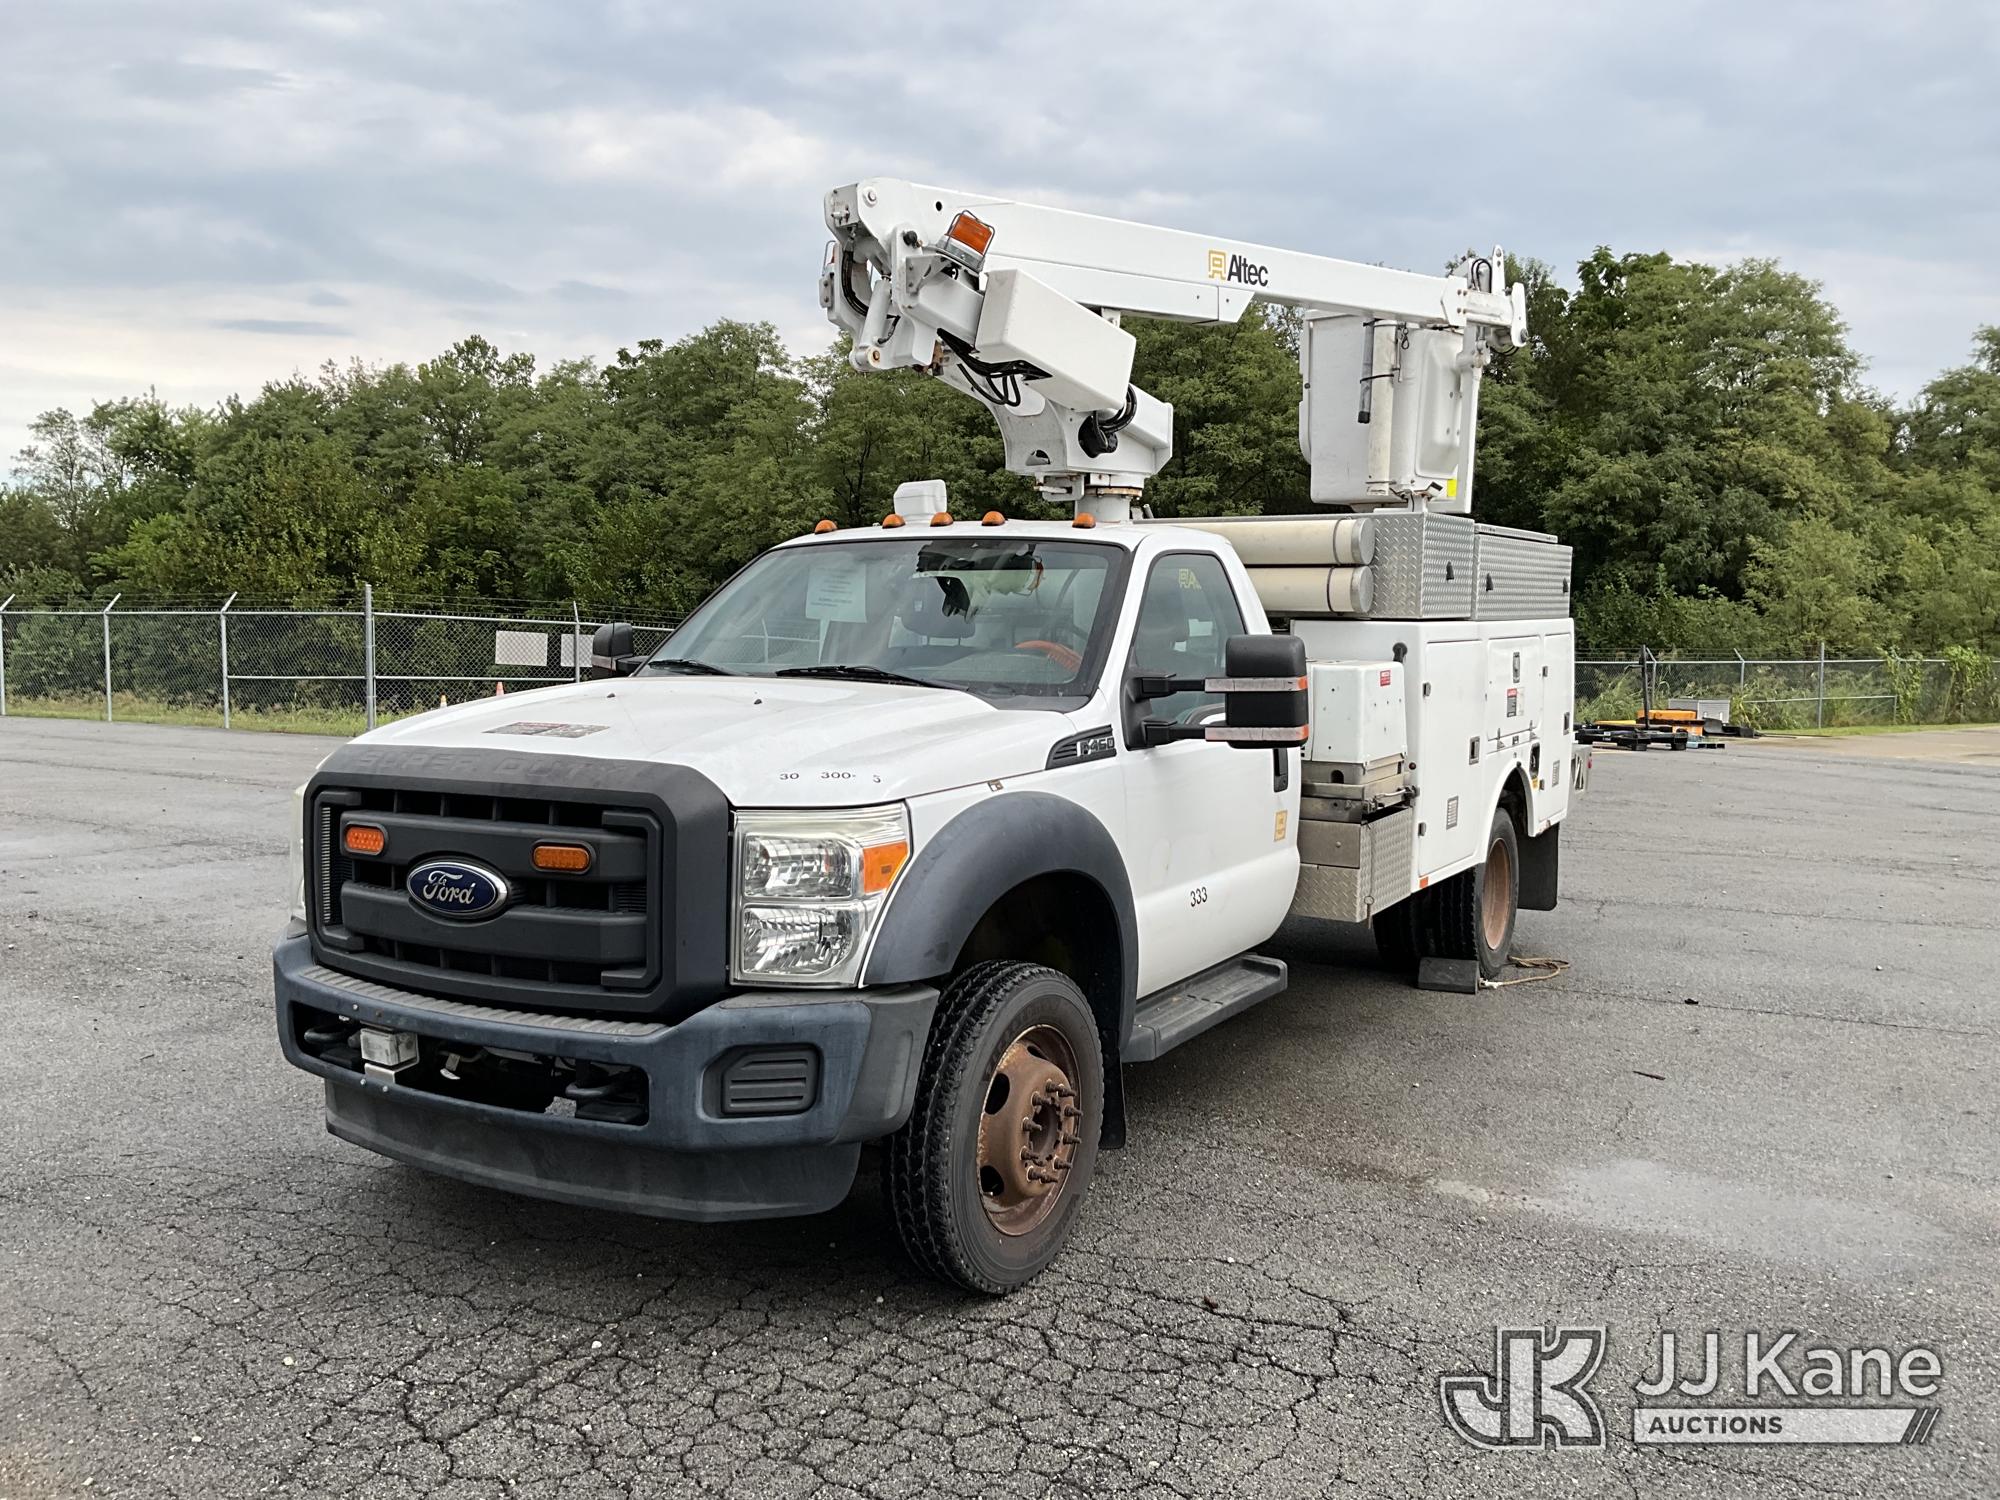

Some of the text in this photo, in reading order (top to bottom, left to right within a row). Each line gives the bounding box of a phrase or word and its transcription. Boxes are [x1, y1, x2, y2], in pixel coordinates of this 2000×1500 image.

[1227, 254, 1268, 287] Altec
[355, 751, 631, 781] SUPER DUTY
[422, 870, 477, 904] Ford
[1190, 886, 1208, 907] 333
